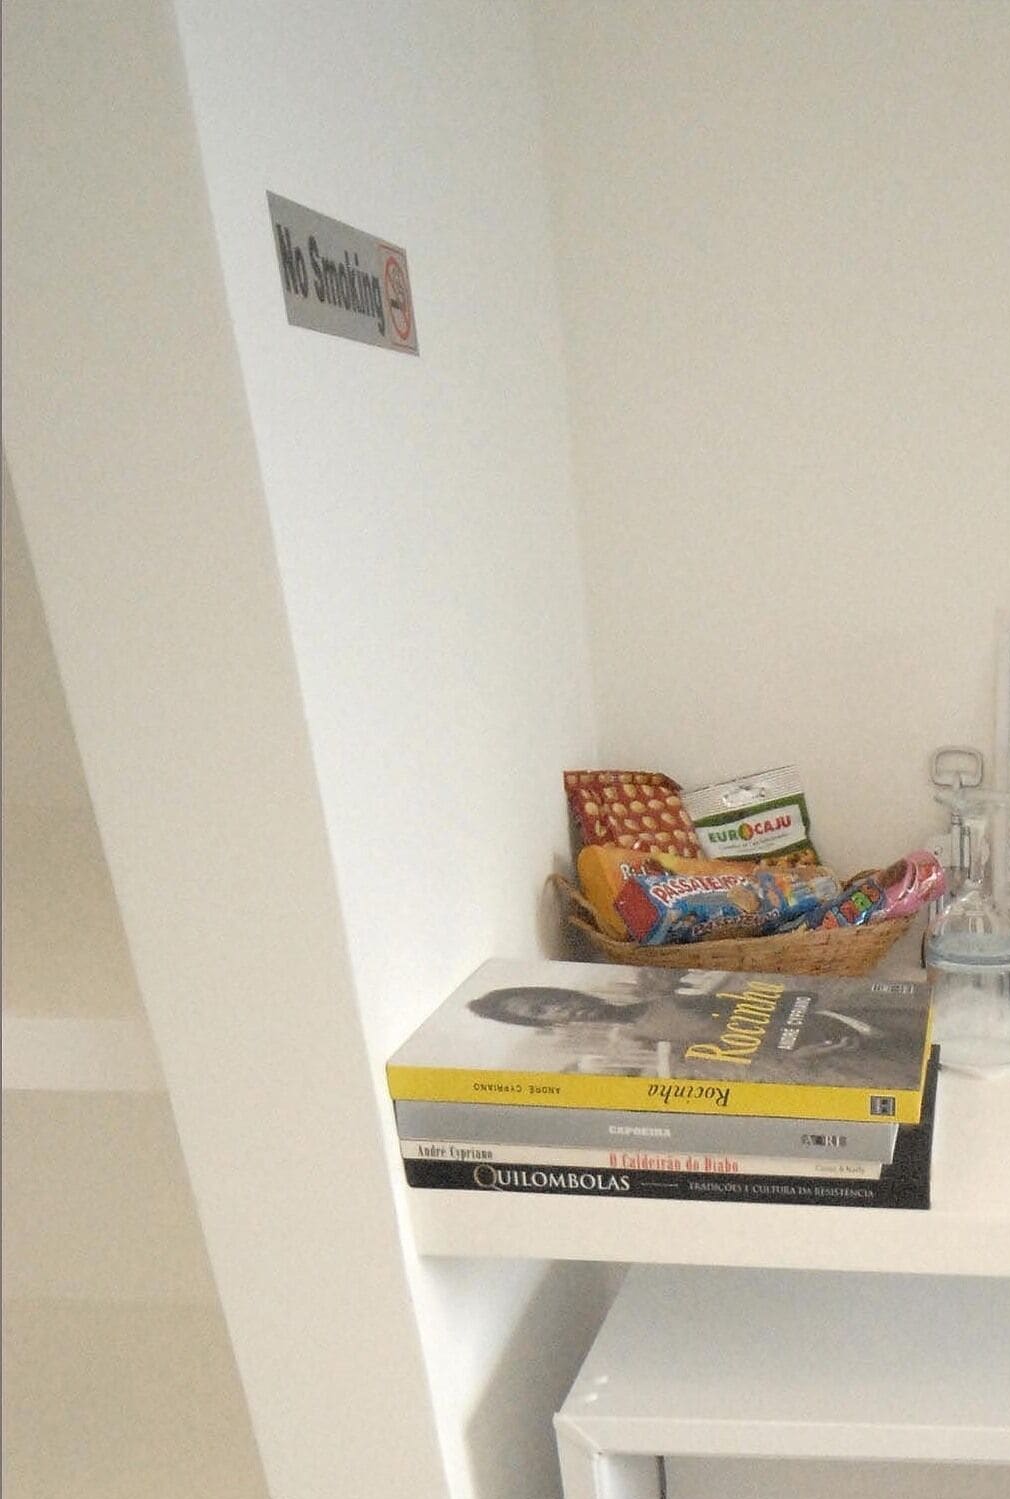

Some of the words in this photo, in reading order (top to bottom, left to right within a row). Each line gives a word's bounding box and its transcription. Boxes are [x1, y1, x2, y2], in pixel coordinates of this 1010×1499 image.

[275, 223, 309, 299] No
[308, 235, 386, 337] Smoking
[684, 980, 785, 1065] Rocinha
[472, 1081, 523, 1094] CYPRIANO
[529, 1083, 561, 1095] ANDRÉ
[647, 1083, 731, 1107] Rocinha
[608, 1124, 671, 1139] CAPOEIRA
[417, 1144, 446, 1158] André
[449, 1146, 494, 1161] Cypriano
[621, 1152, 682, 1171] Caldeirão
[685, 1156, 700, 1172] do
[703, 1156, 740, 1173] Diabo
[473, 1164, 631, 1193] QUILOMBOLAS
[752, 1184, 796, 1196] CULTURA
[798, 1186, 813, 1197] DA
